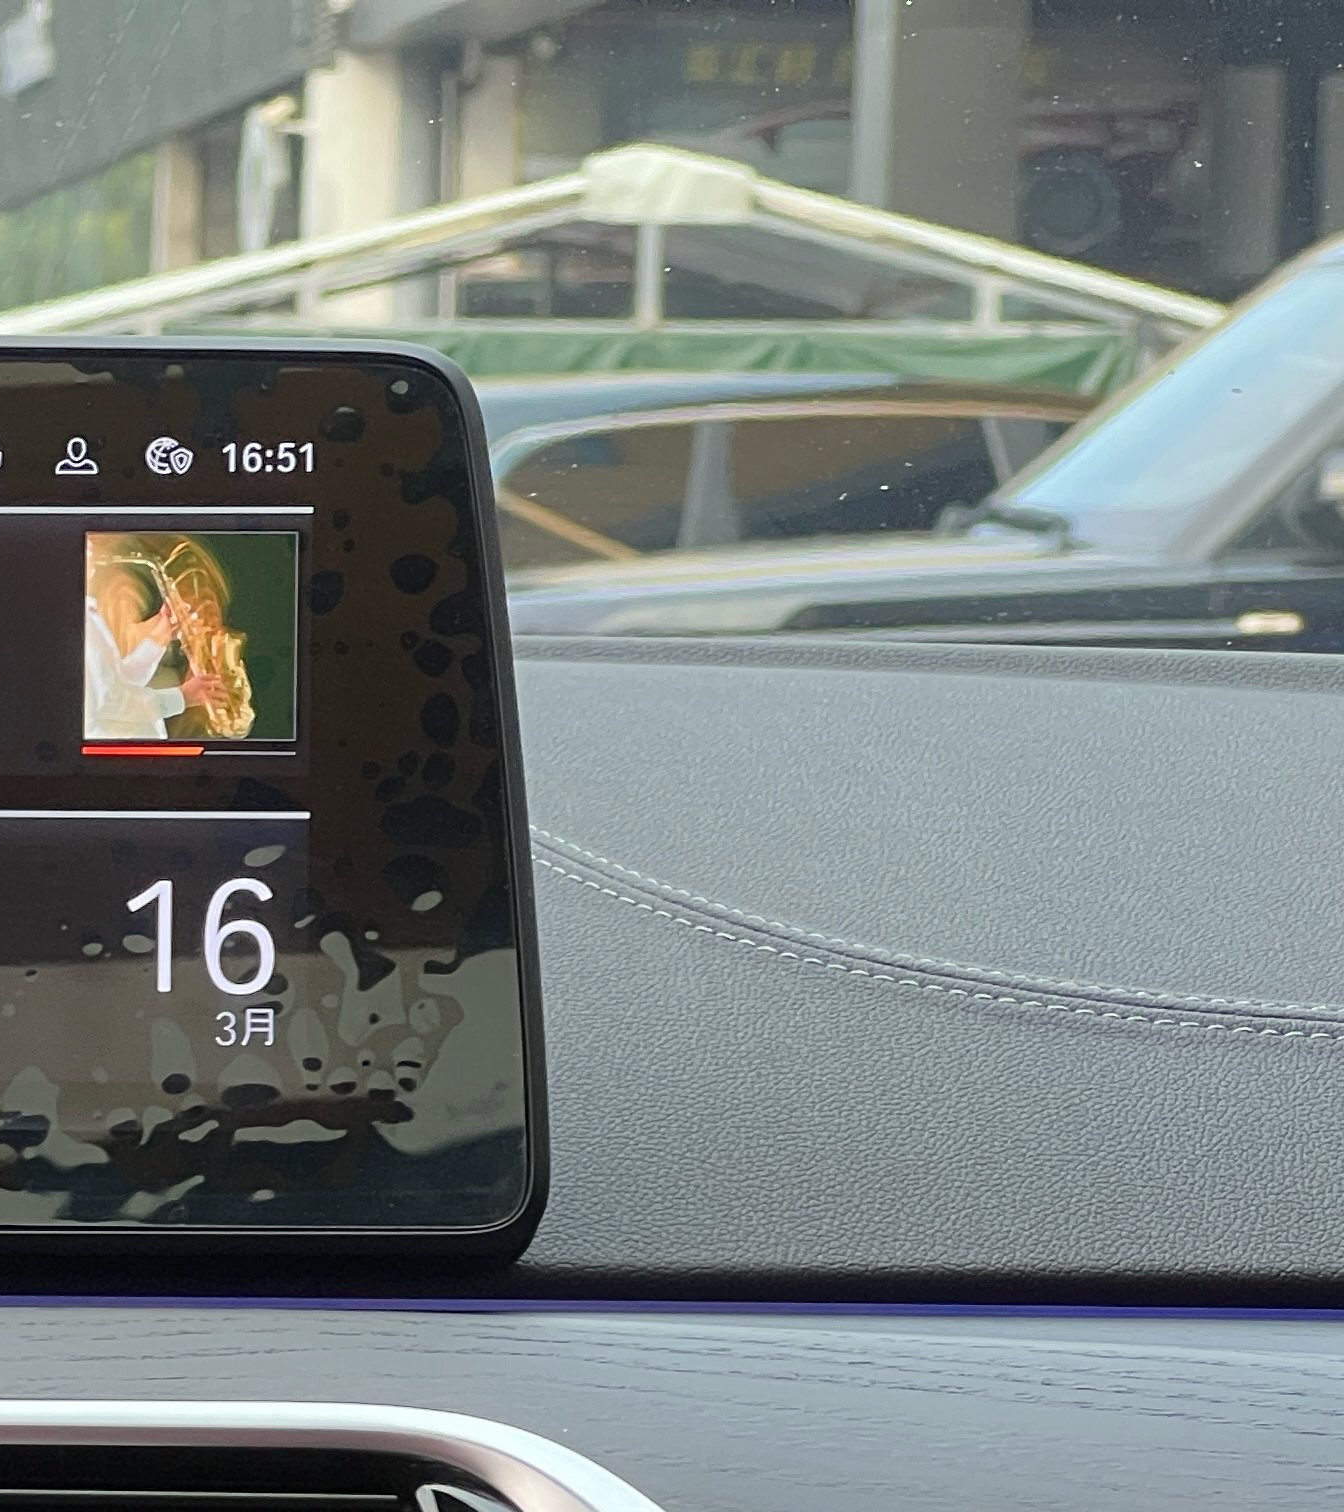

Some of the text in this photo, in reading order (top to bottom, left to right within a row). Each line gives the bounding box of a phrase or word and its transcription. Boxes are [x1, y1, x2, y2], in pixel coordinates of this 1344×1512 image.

[222, 442, 314, 473] 16:51
[127, 877, 276, 996] 16
[214, 1007, 275, 1047] 3月
